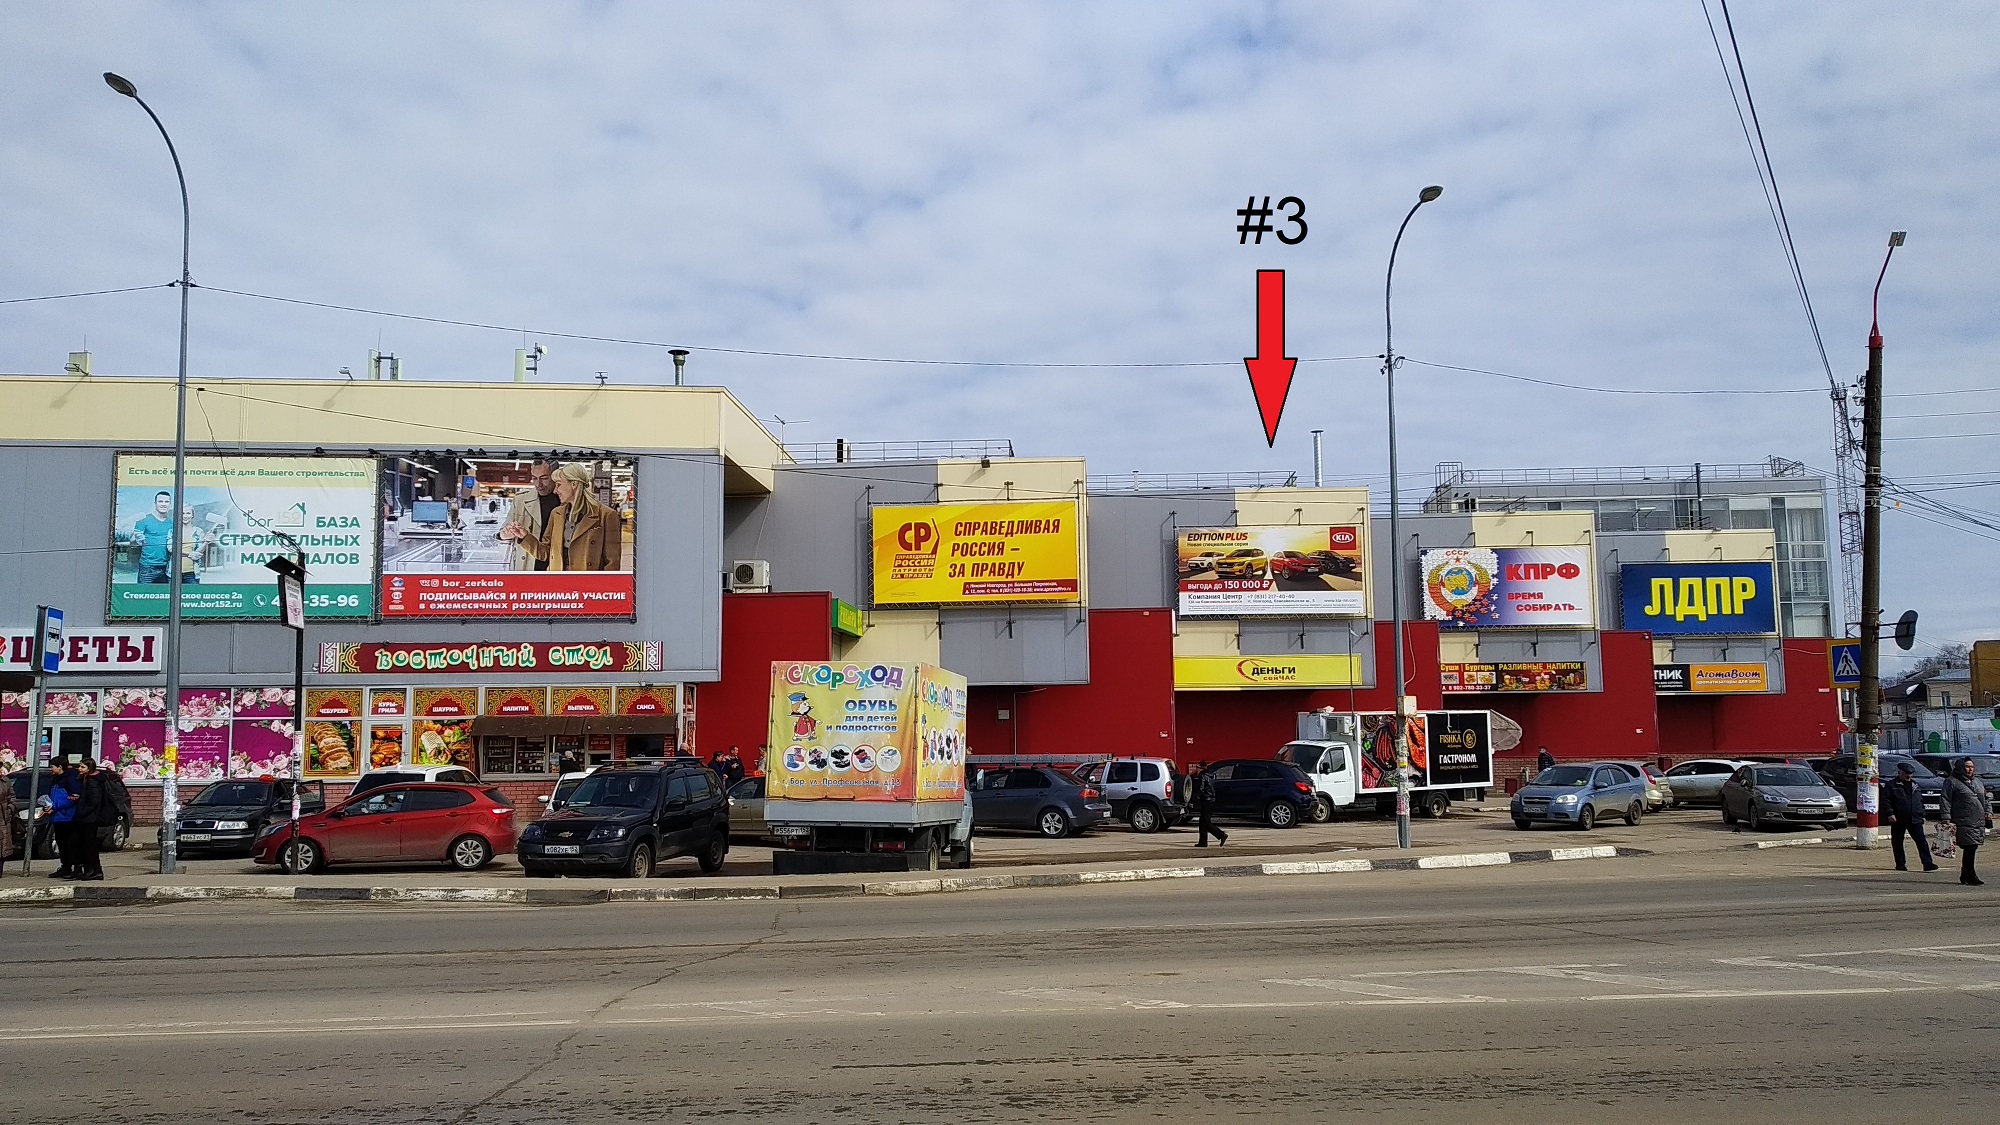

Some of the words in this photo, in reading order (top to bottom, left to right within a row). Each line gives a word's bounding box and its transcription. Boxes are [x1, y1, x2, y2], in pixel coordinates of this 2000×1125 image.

[128, 467, 149, 475] Есть
[220, 468, 235, 476] всё
[296, 470, 365, 478] строительства
[316, 517, 360, 528] БАЗА
[954, 519, 1060, 538] СПРАВЕДЛИВАЯ
[898, 522, 932, 551] СР
[1187, 532, 1224, 540] EDITION
[1225, 532, 1248, 540] PLUS
[951, 542, 1005, 557] РОССИЯ
[948, 563, 965, 578] ЗА
[971, 561, 1025, 579] ПРАВДУ
[1505, 563, 1580, 581] КПРФ
[443, 579, 504, 588] bor_zerkalo
[1224, 581, 1239, 589] 150
[1242, 580, 1260, 588] 000
[123, 591, 201, 599] Стеклозавское
[420, 591, 506, 601] ПОДПИСЫВАЙСЯ
[509, 592, 517, 600] И
[520, 591, 579, 600] ПРИНИМАЙ
[582, 592, 626, 600] УЧАСТИЕ
[1507, 592, 1543, 600] ВРЕМЯ
[1644, 577, 1756, 622] ЛДПР
[181, 600, 243, 608] ww.bor152.ru
[10, 636, 155, 663] ЦЕТЫ
[1252, 667, 1296, 676] ДЕНЬГИ
[1465, 664, 1495, 672] Бургеры
[787, 664, 903, 690] СКОРОХОД
[1697, 669, 1760, 679] AromaBoom
[845, 700, 898, 712] ОБУВЬ
[867, 714, 897, 722] детей
[1439, 754, 1477, 764] ГАСТРОНОМ
